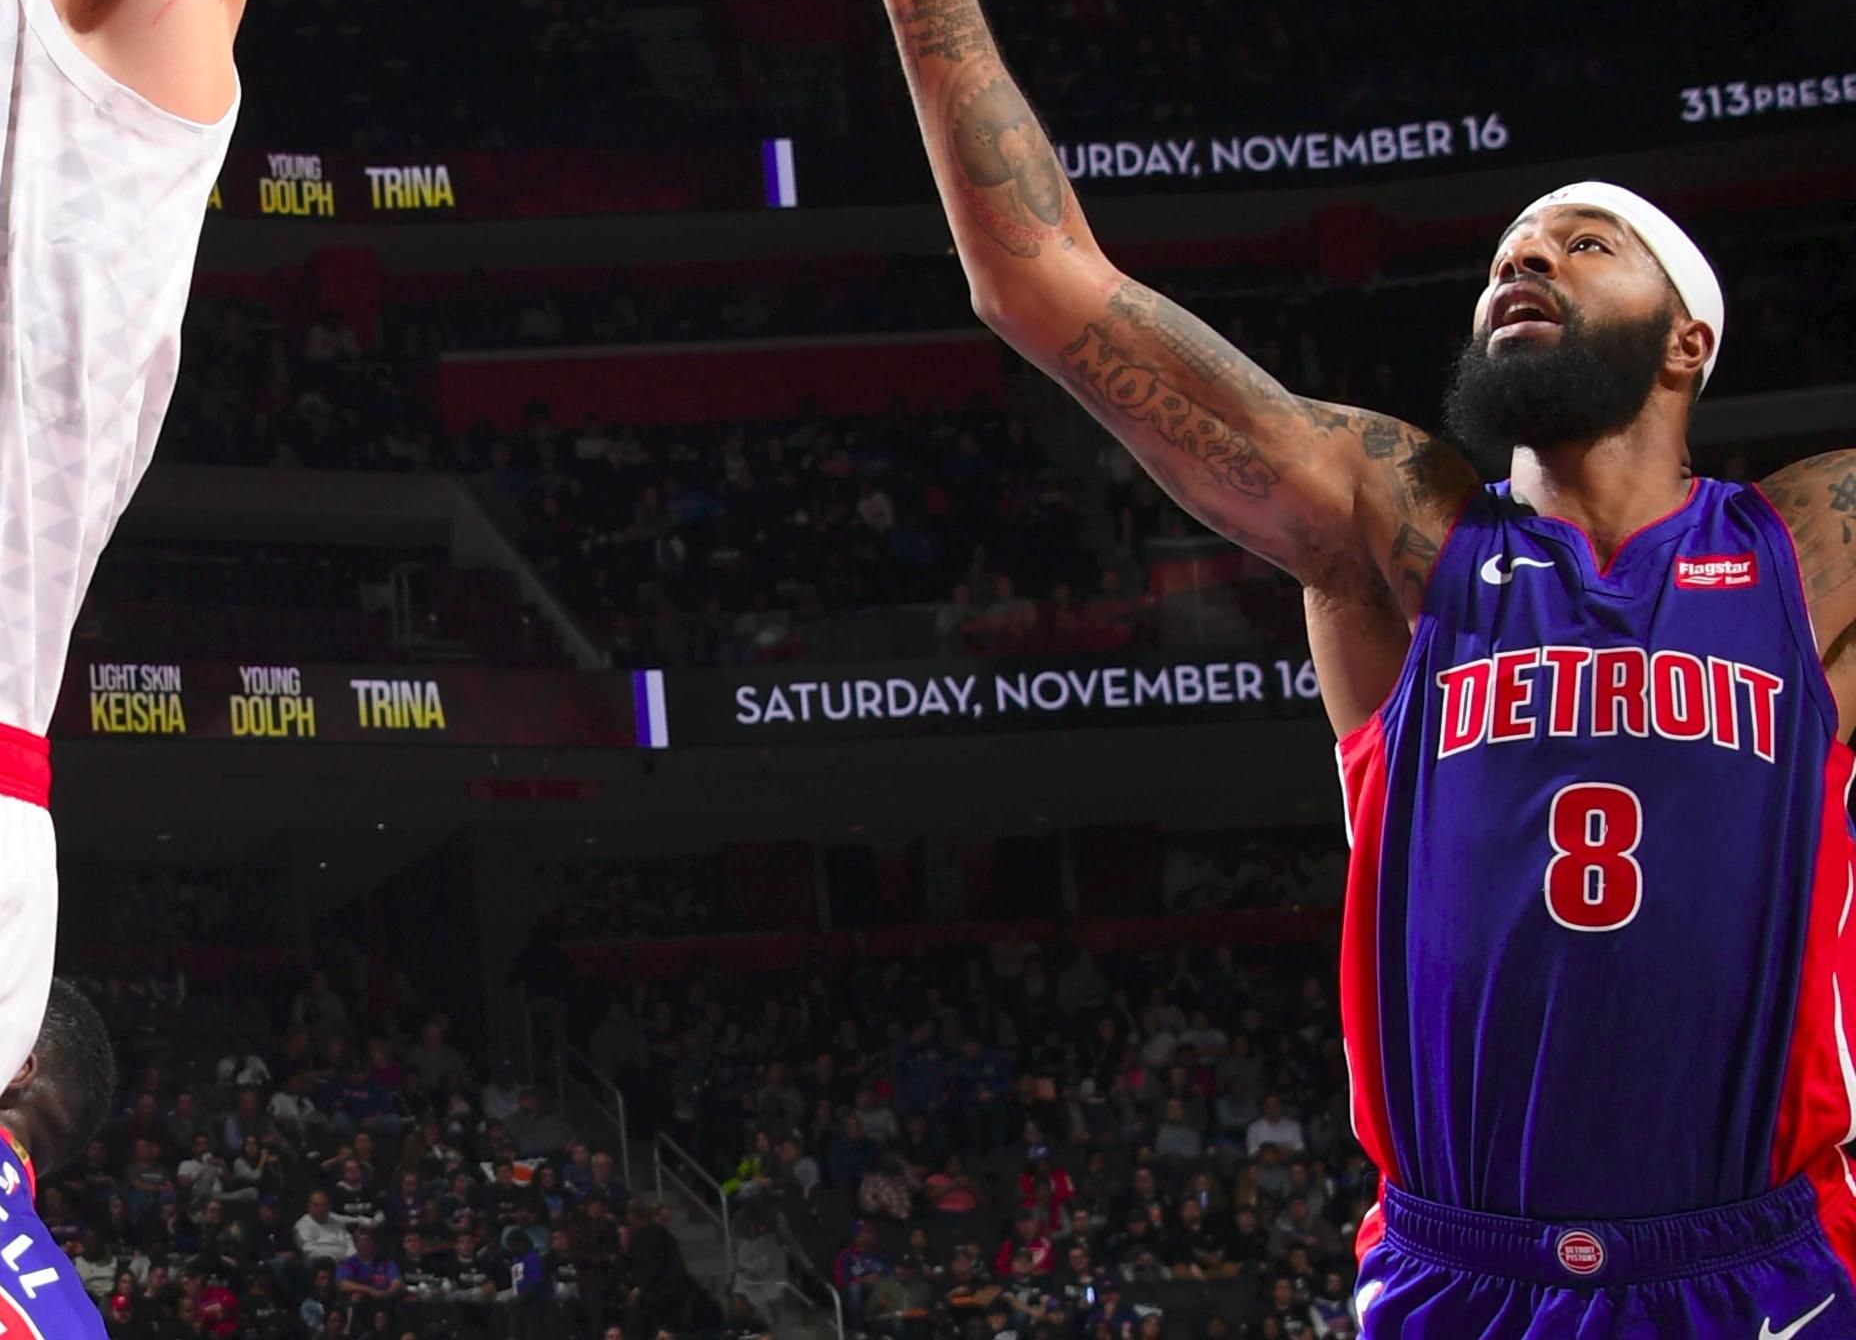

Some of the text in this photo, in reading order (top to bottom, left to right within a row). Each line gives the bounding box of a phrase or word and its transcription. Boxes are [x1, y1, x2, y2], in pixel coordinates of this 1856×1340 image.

[267, 152, 322, 180] YOUNG
[1056, 114, 1509, 179] URDAY, NOVEMBER 16
[259, 177, 335, 216] DOLPH
[365, 165, 455, 210] TRINA
[1678, 561, 1751, 576] Flagstar
[89, 663, 182, 691] LIGHT SKIN
[239, 665, 301, 696] YOUNG
[735, 659, 1320, 725] SATURDAY, NOVEMBER 16
[90, 691, 186, 734] KEISHA
[230, 695, 316, 737] DOLPH
[350, 678, 446, 729] TRINA
[1435, 645, 1784, 765] DETROIT
[1544, 781, 1643, 932] 8
